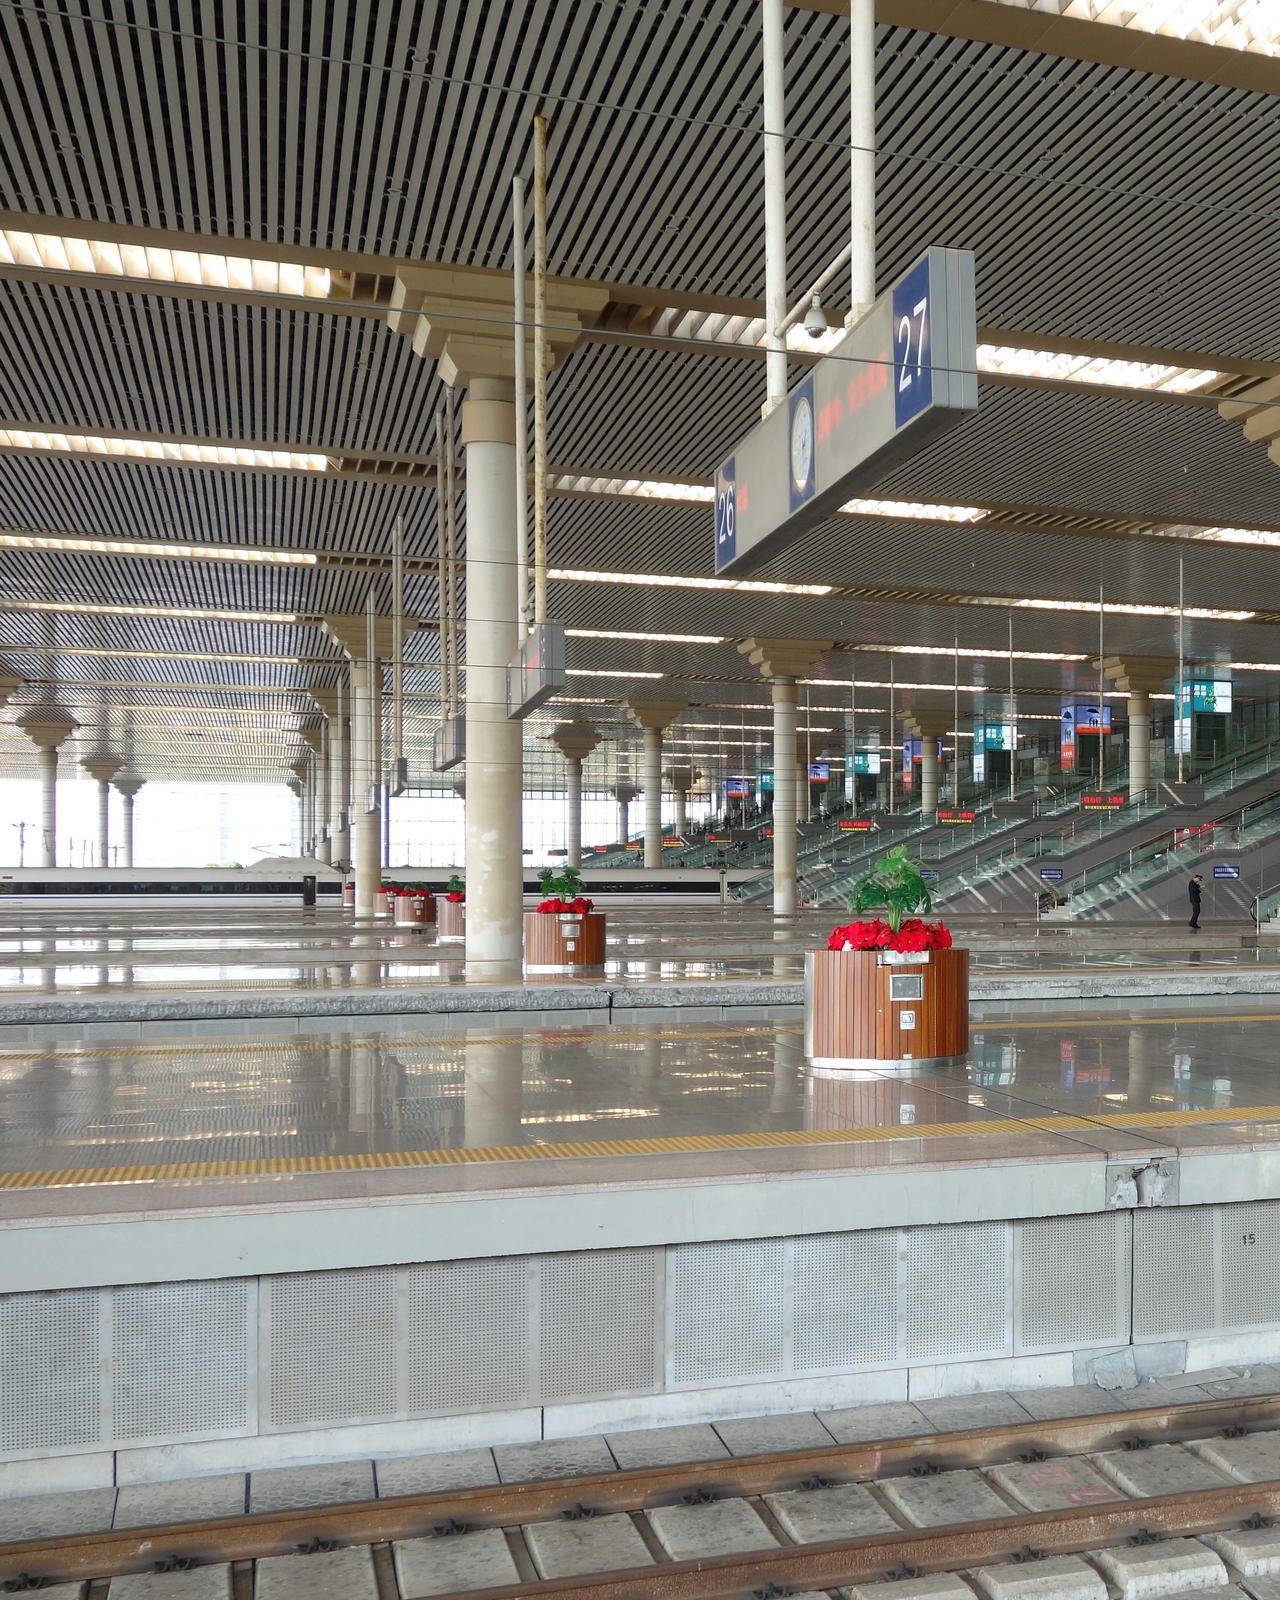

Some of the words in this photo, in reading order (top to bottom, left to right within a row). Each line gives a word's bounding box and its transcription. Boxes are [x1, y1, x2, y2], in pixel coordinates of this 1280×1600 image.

[897, 297, 928, 393] 27
[718, 486, 735, 545] 26
[1242, 1233, 1256, 1246] 15
